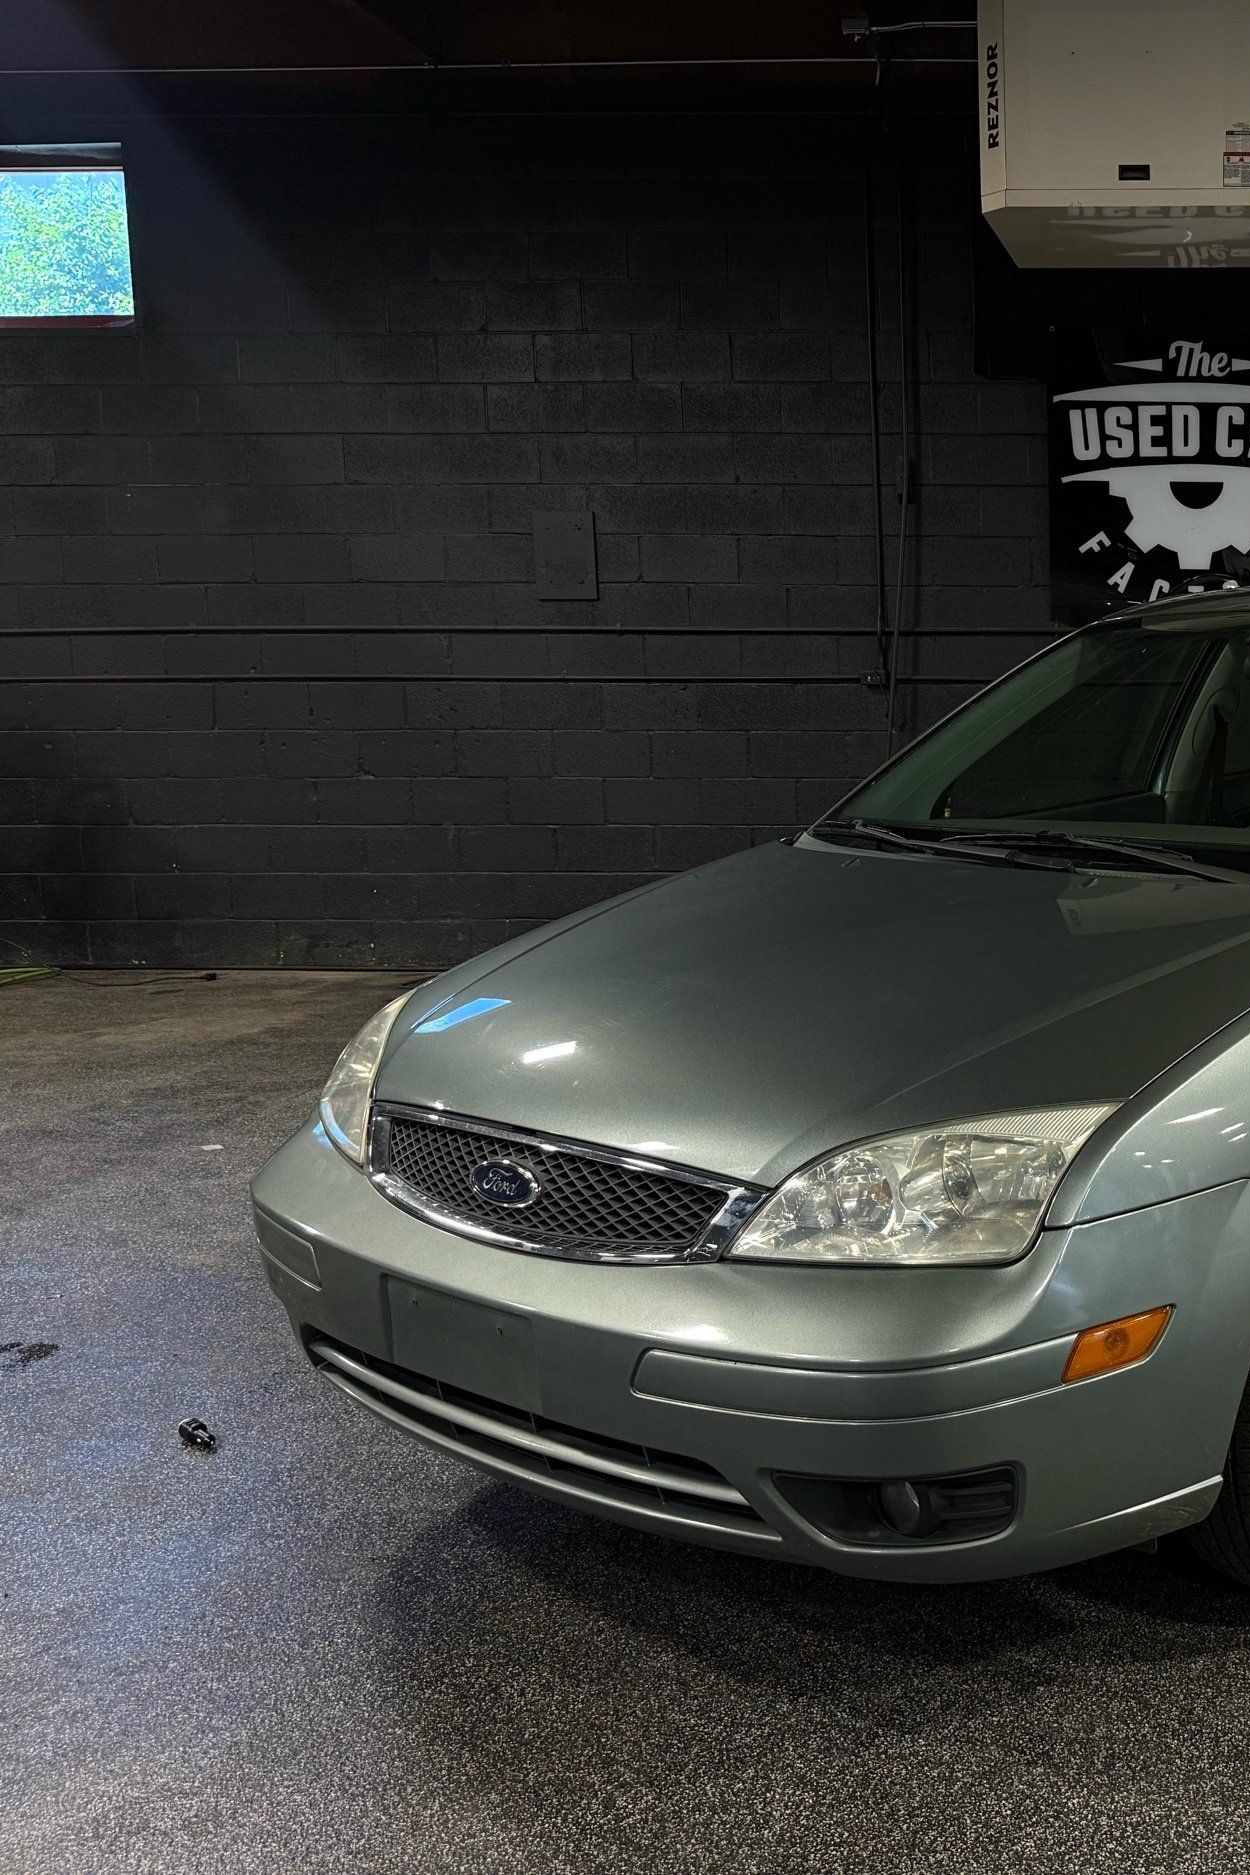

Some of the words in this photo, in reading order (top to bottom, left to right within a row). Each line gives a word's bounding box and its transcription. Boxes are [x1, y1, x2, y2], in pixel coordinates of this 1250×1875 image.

[987, 42, 999, 149] REZNOR
[1169, 340, 1231, 377] The
[1068, 405, 1201, 461] USED
[483, 1167, 520, 1196] Ford
